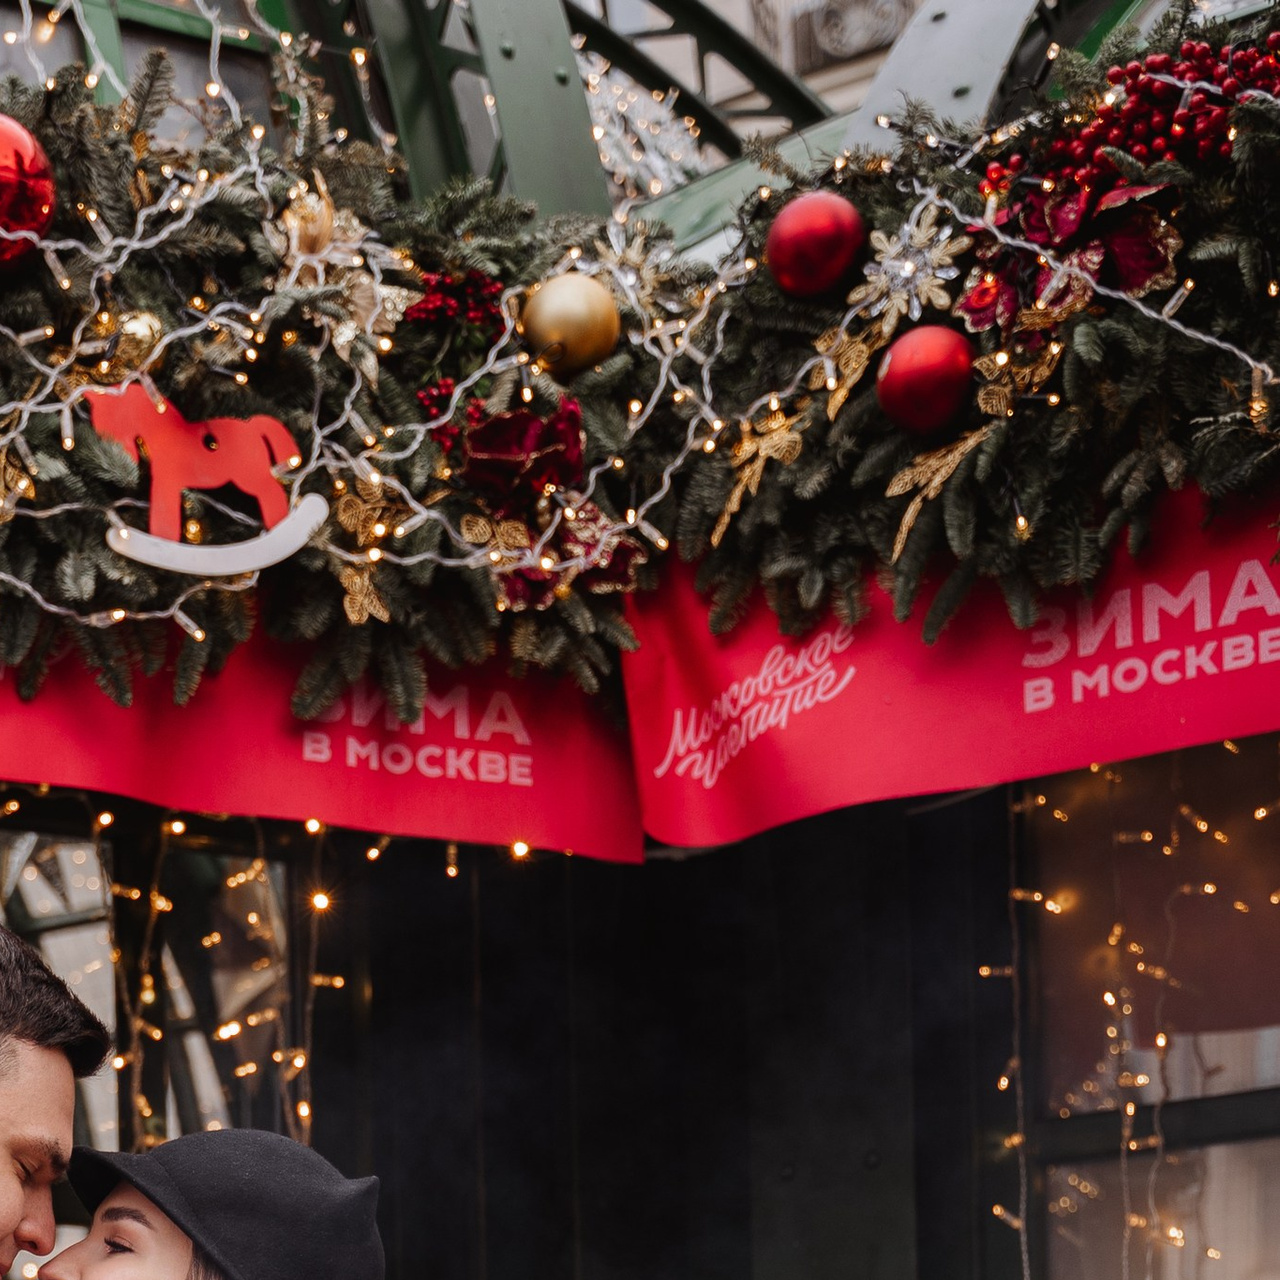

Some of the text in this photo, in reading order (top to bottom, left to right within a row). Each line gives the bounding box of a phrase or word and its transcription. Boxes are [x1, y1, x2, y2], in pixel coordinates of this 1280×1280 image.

[1022, 559, 1280, 669] ЗИМА
[1024, 627, 1280, 715] В МОСКВЕ
[316, 680, 532, 746] ИМА
[303, 731, 534, 787] В МОСКВЕ
